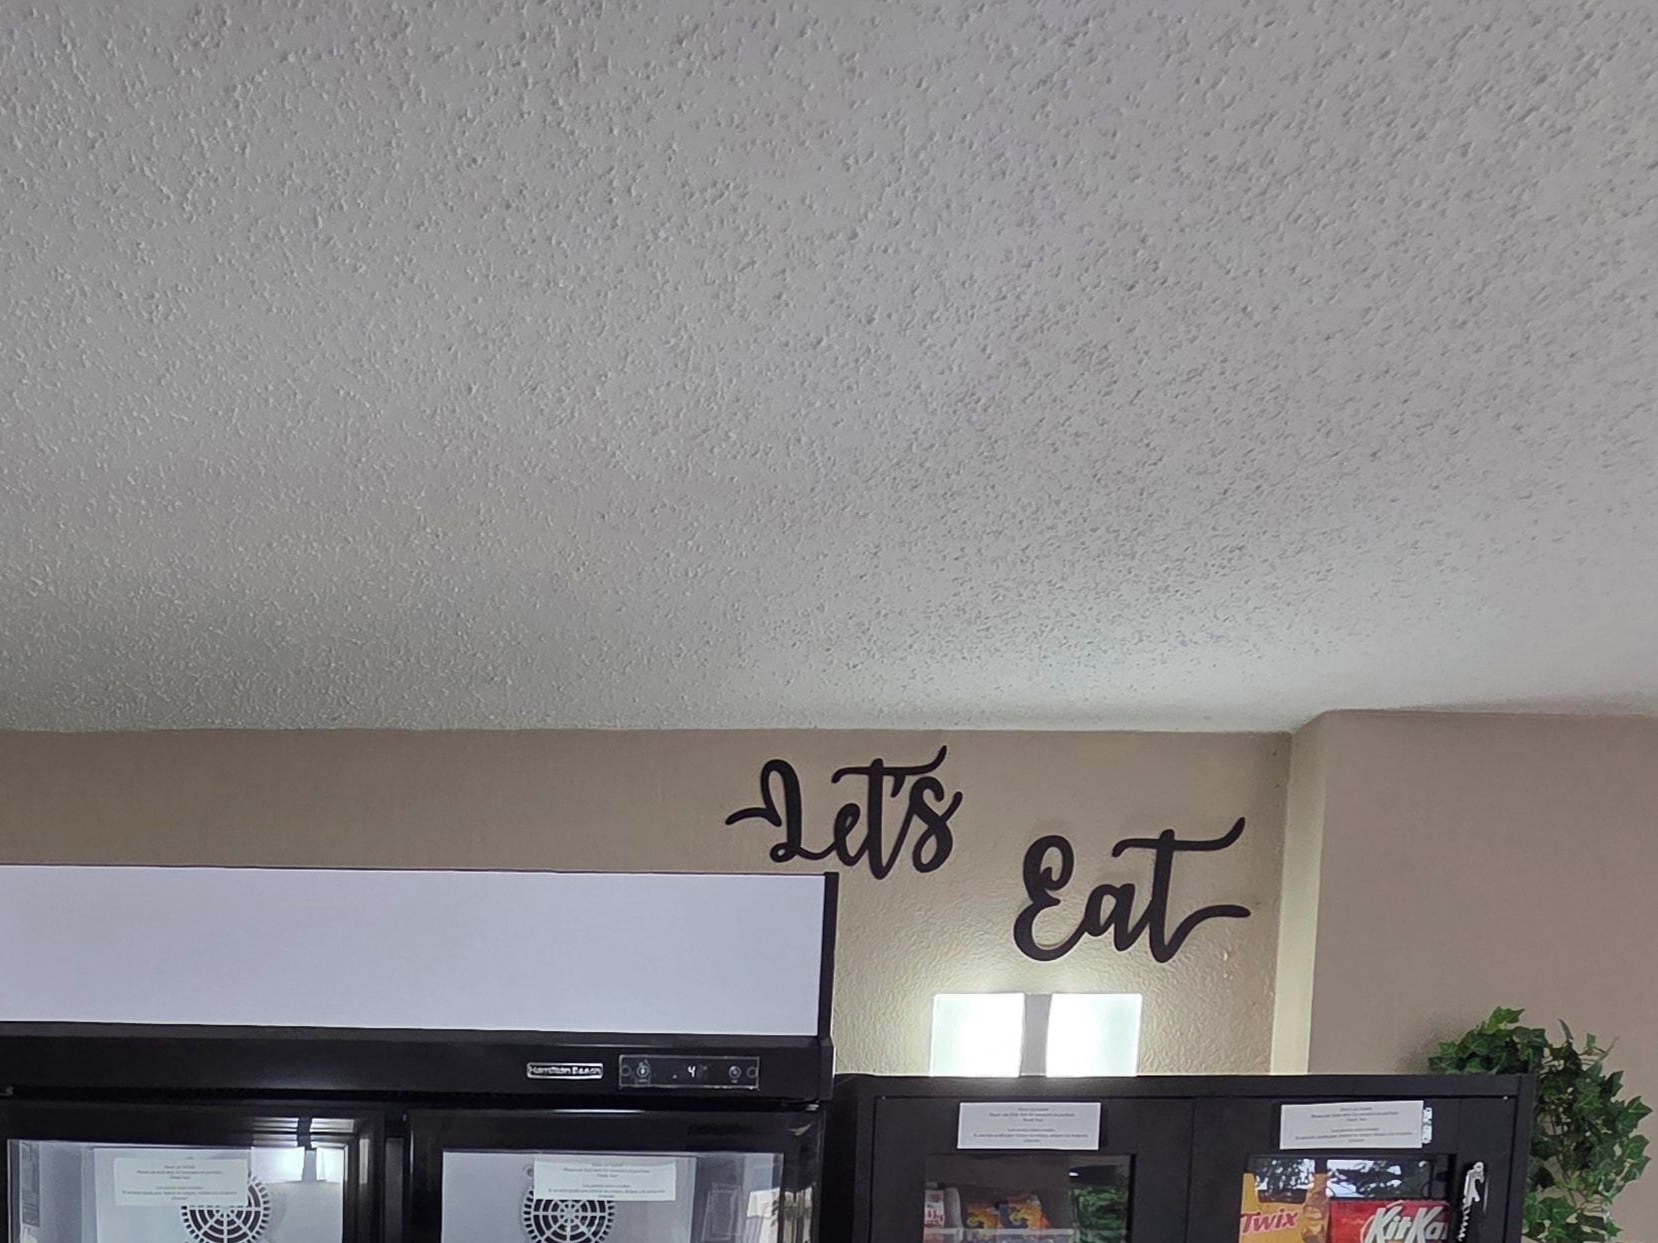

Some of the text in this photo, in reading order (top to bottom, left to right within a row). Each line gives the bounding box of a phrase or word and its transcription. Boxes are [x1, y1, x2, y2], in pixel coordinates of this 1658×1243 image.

[726, 744, 963, 880] Let's
[1013, 816, 1251, 963] Eat
[1241, 1208, 1301, 1235] Twix
